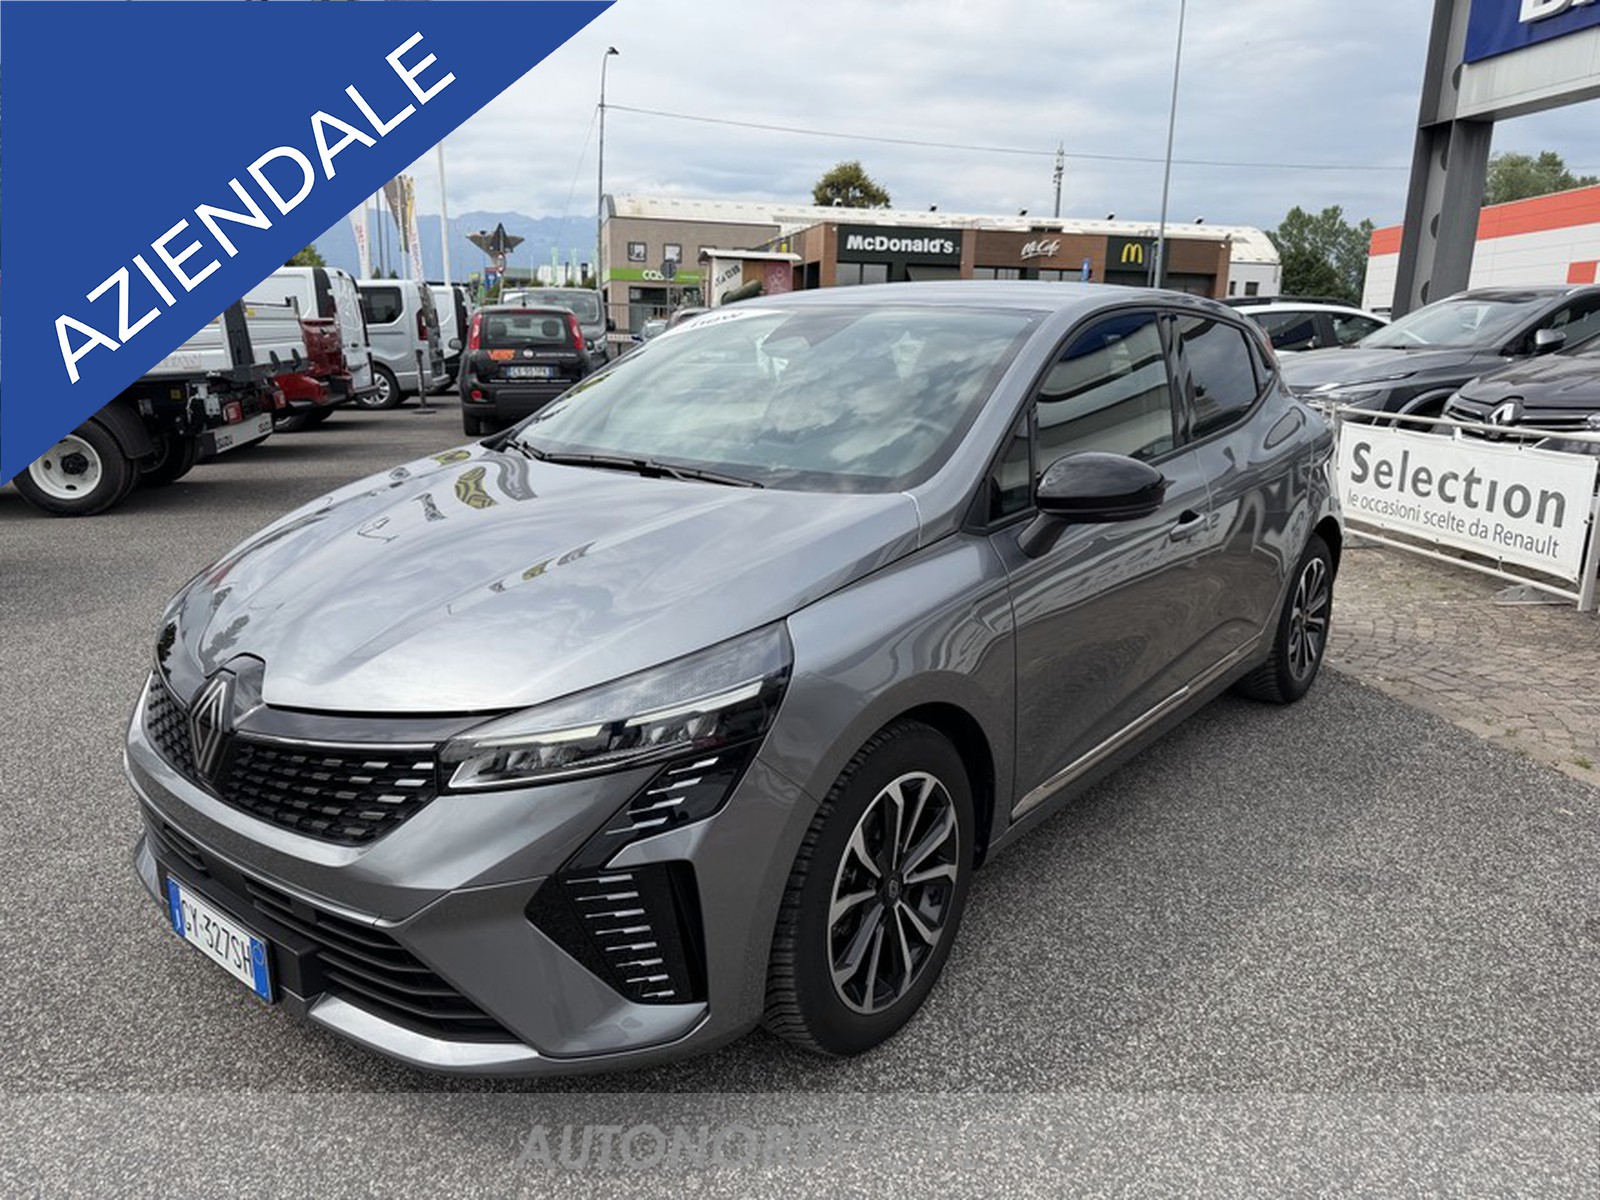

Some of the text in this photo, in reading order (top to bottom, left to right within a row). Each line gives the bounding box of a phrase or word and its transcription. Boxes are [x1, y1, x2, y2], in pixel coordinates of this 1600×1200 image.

[846, 234, 955, 254] McDonald's
[1350, 441, 1567, 529] Selection
[1347, 488, 1560, 559] le occasioni scelte da Renault
